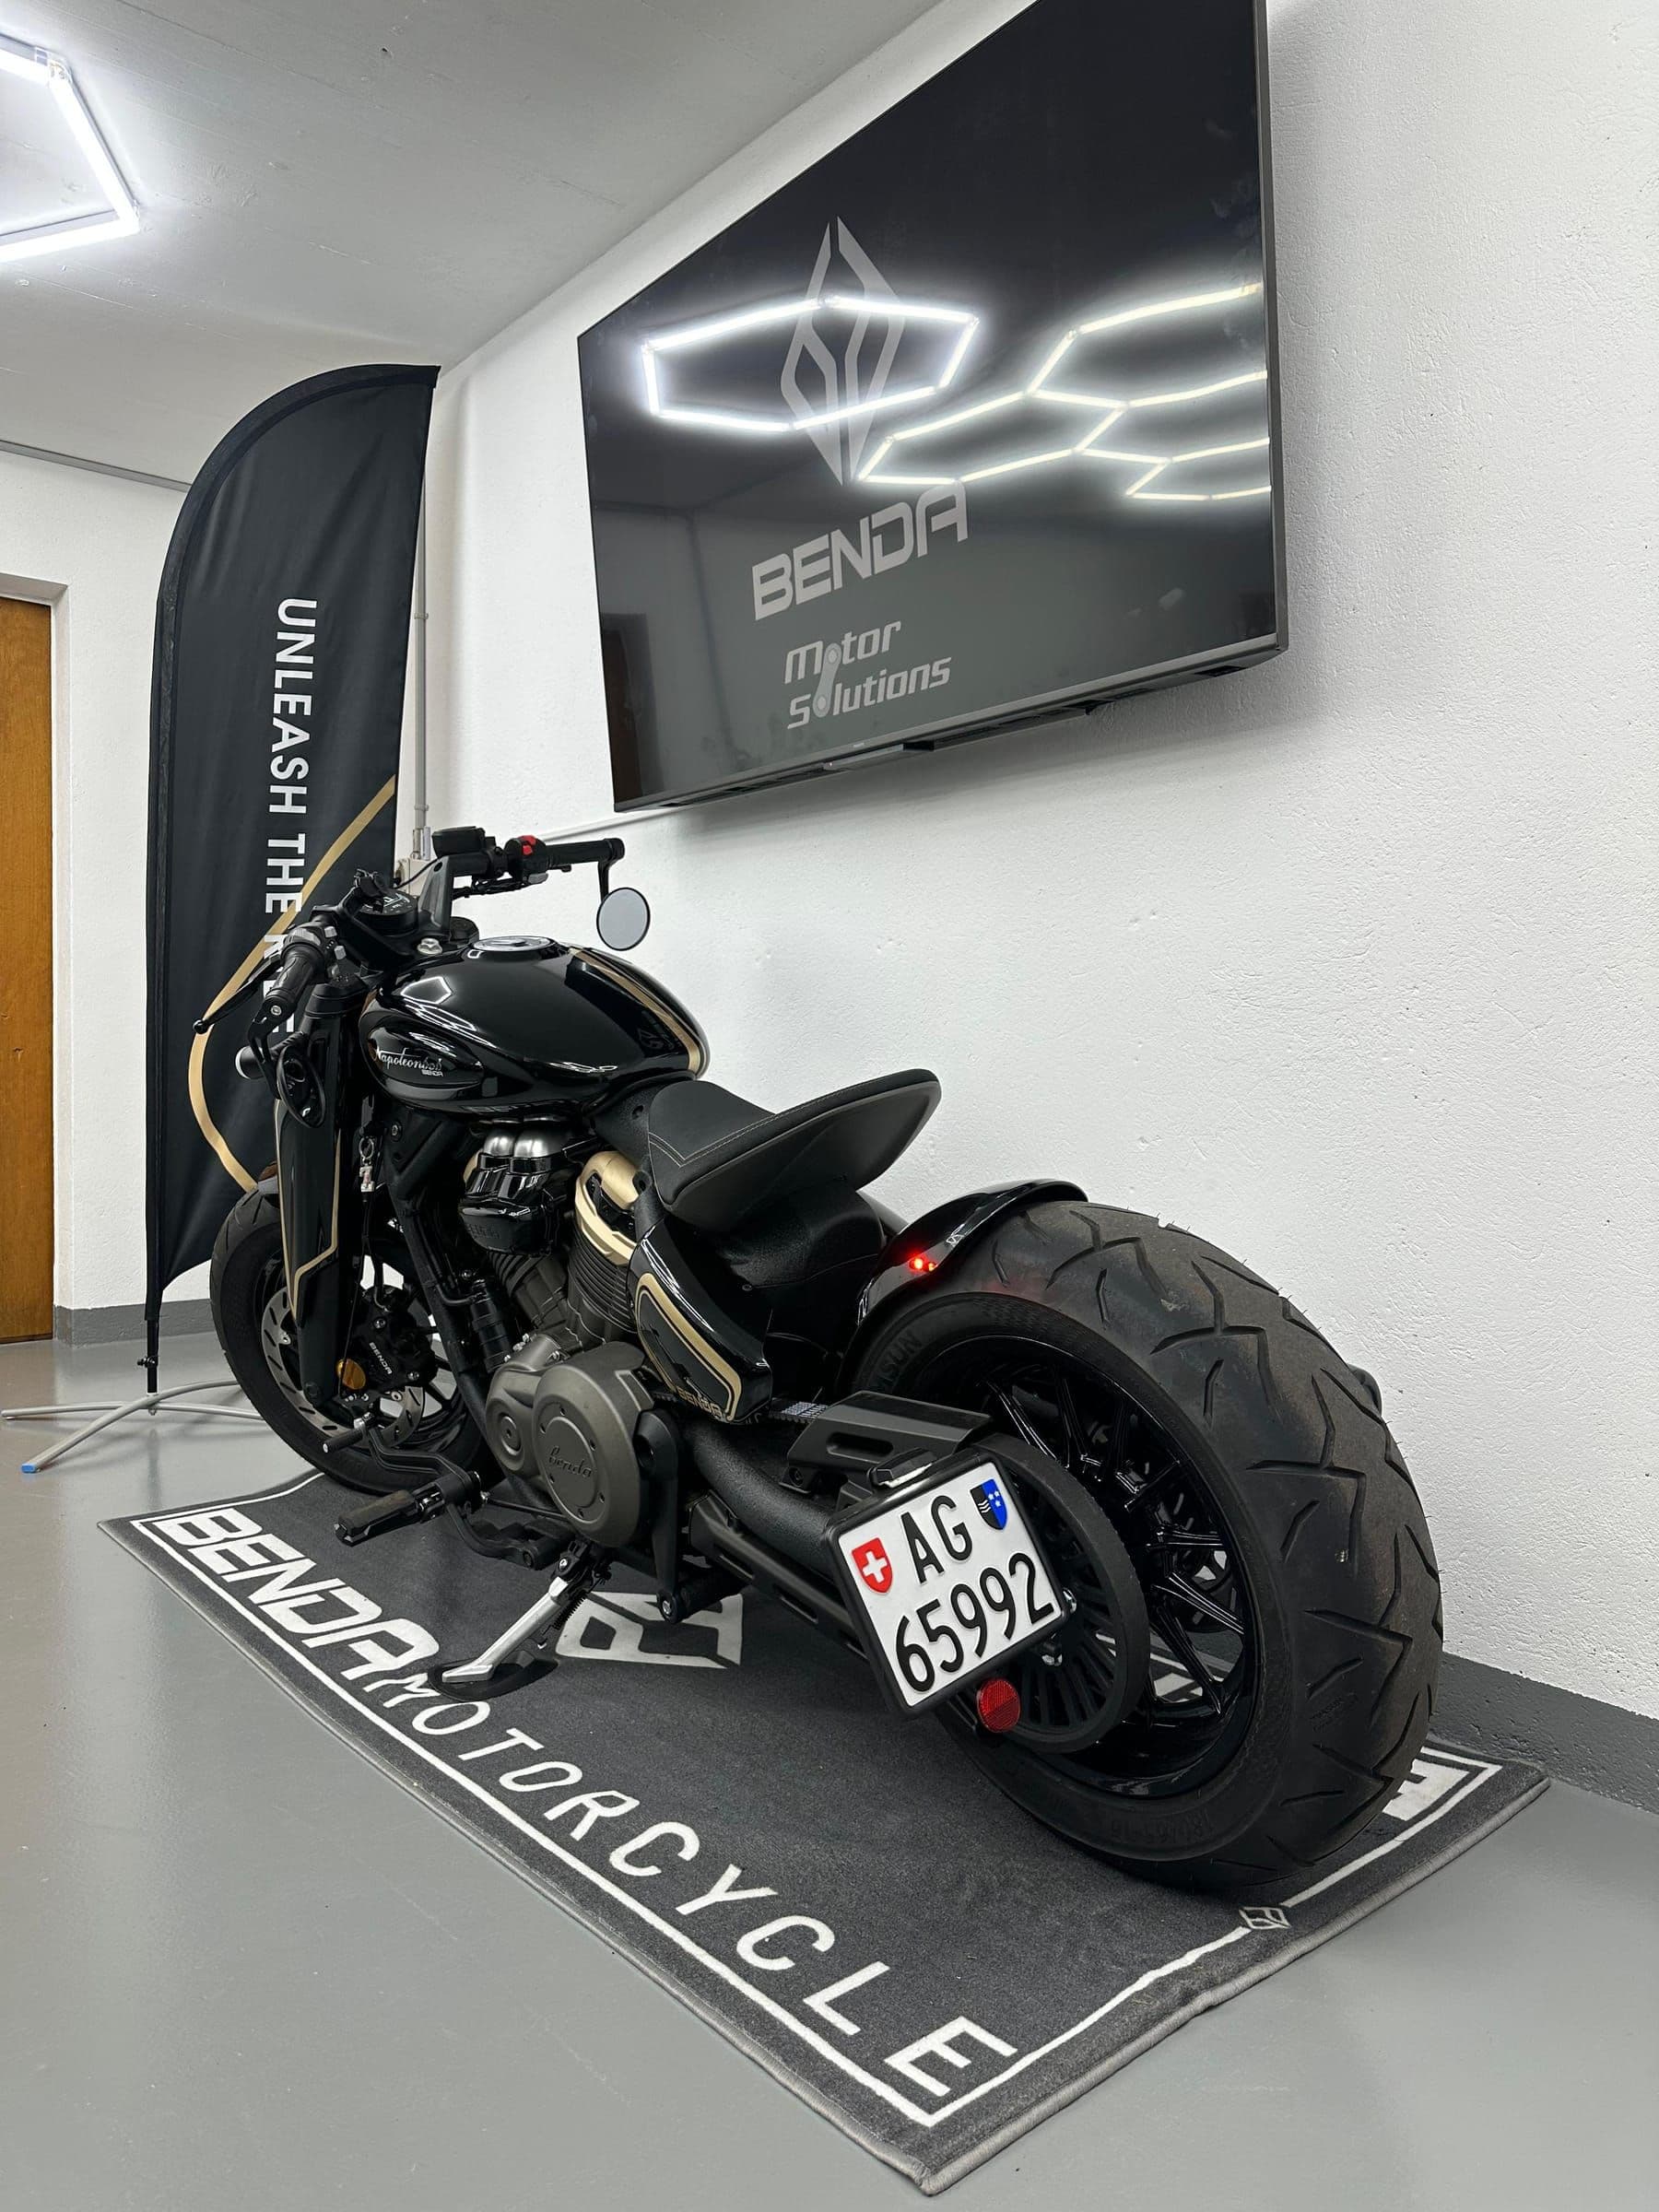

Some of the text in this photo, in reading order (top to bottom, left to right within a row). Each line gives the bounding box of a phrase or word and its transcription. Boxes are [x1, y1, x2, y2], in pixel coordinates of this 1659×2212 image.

[751, 480, 969, 620] BENDA
[267, 597, 318, 815] UNLEASH
[786, 656, 952, 729] Solutions
[265, 833, 306, 914] THE
[369, 1341, 393, 1375] BENDA
[900, 1494, 973, 1584] AG
[895, 1552, 1054, 1692] 65992
[151, 1508, 1018, 2098] BENDA MOTORCYCLE
